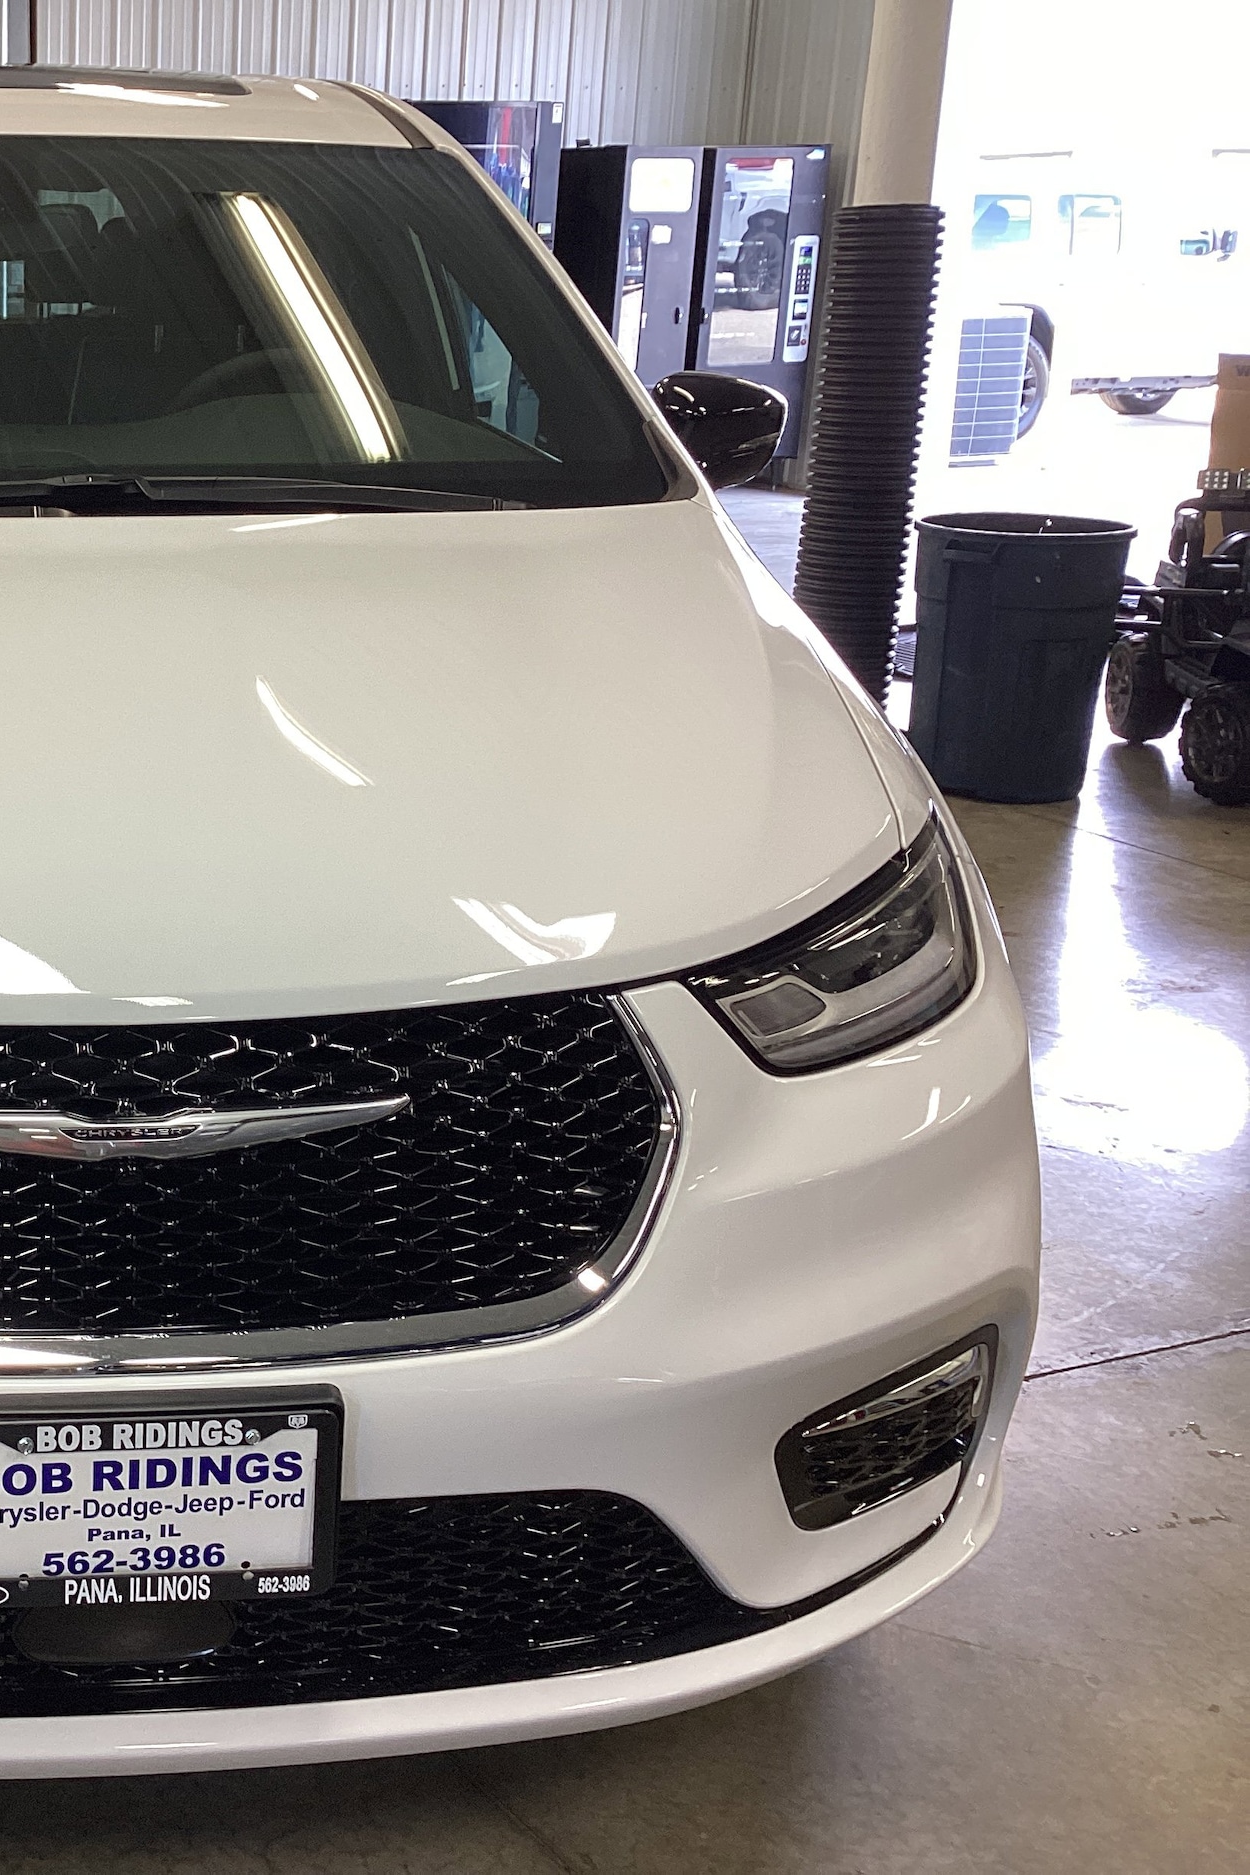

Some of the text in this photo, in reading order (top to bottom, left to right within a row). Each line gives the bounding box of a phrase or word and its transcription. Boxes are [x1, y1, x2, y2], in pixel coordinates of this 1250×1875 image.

[36, 1419, 244, 1453] BOB RIDINGS
[92, 1451, 303, 1492] RIDINGS
[87, 1523, 182, 1542] Pana, IL
[42, 1542, 226, 1577] 562-3986
[64, 1574, 211, 1605] PANA, ILLINOIS
[257, 1574, 311, 1595] 562-3986
